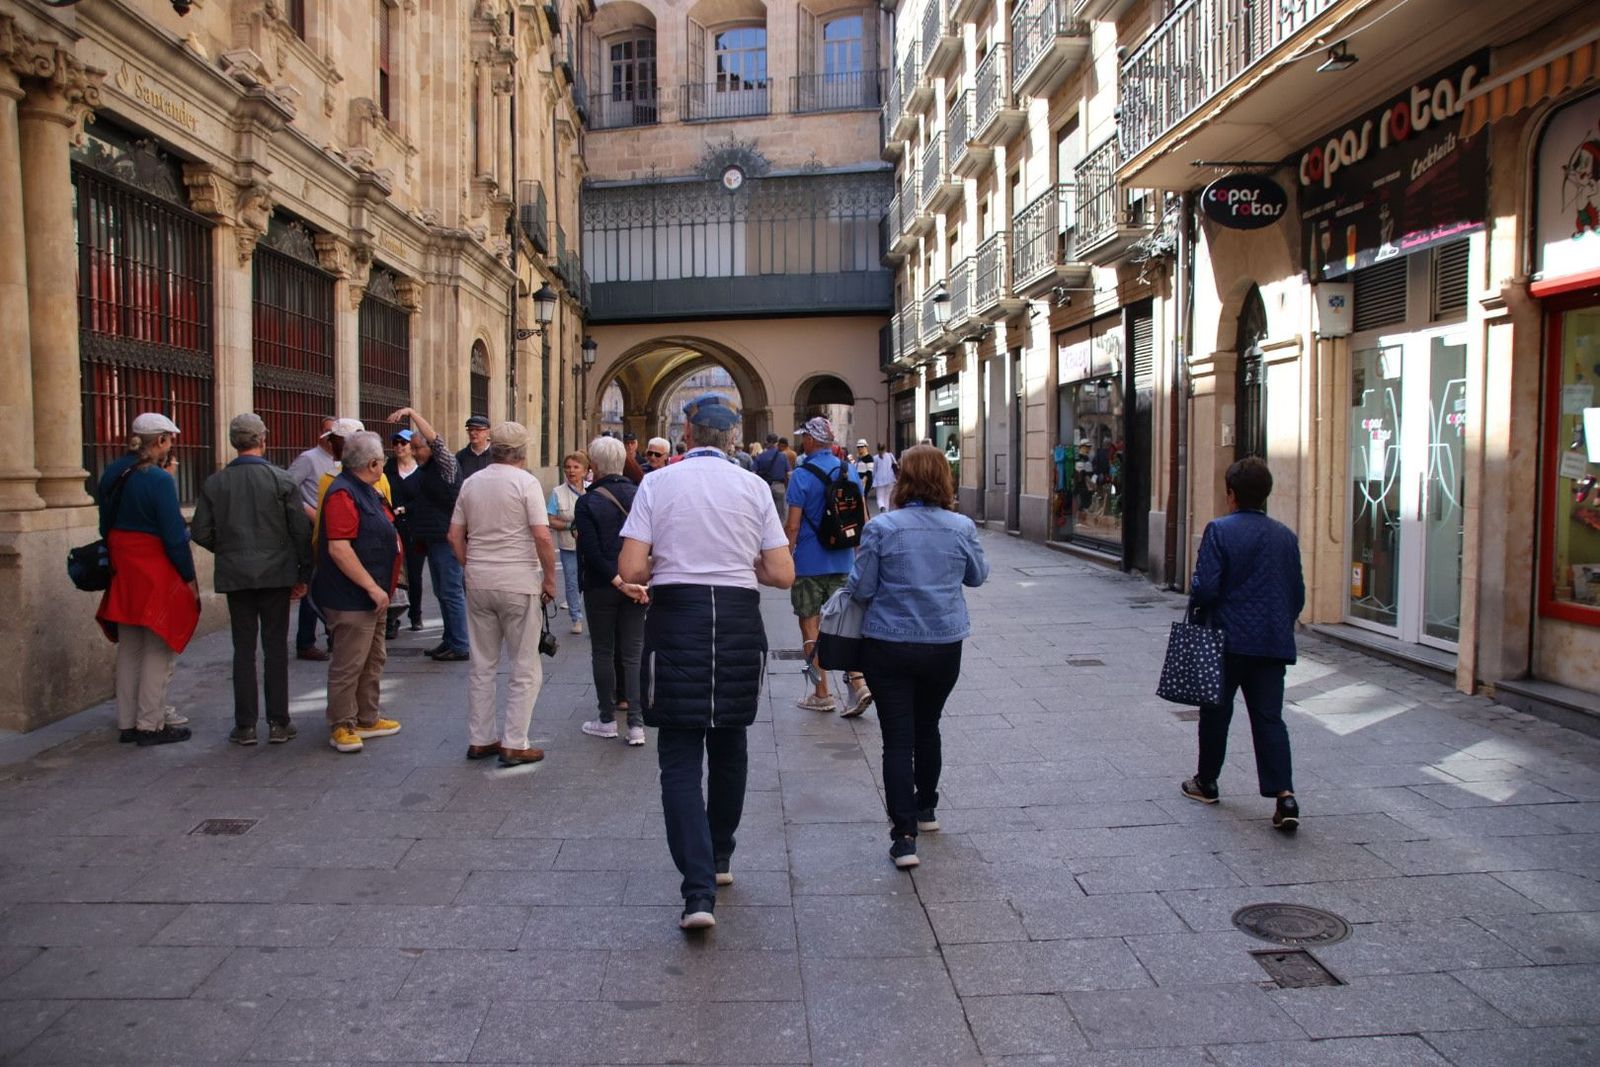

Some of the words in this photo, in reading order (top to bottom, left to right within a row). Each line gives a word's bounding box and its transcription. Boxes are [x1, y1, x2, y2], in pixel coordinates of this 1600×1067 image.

[135, 73, 196, 132] Santander
[1300, 119, 1373, 189] copas
[1379, 65, 1477, 149] rotas
[1208, 189, 1260, 206] copas
[1231, 202, 1283, 216] rotas
